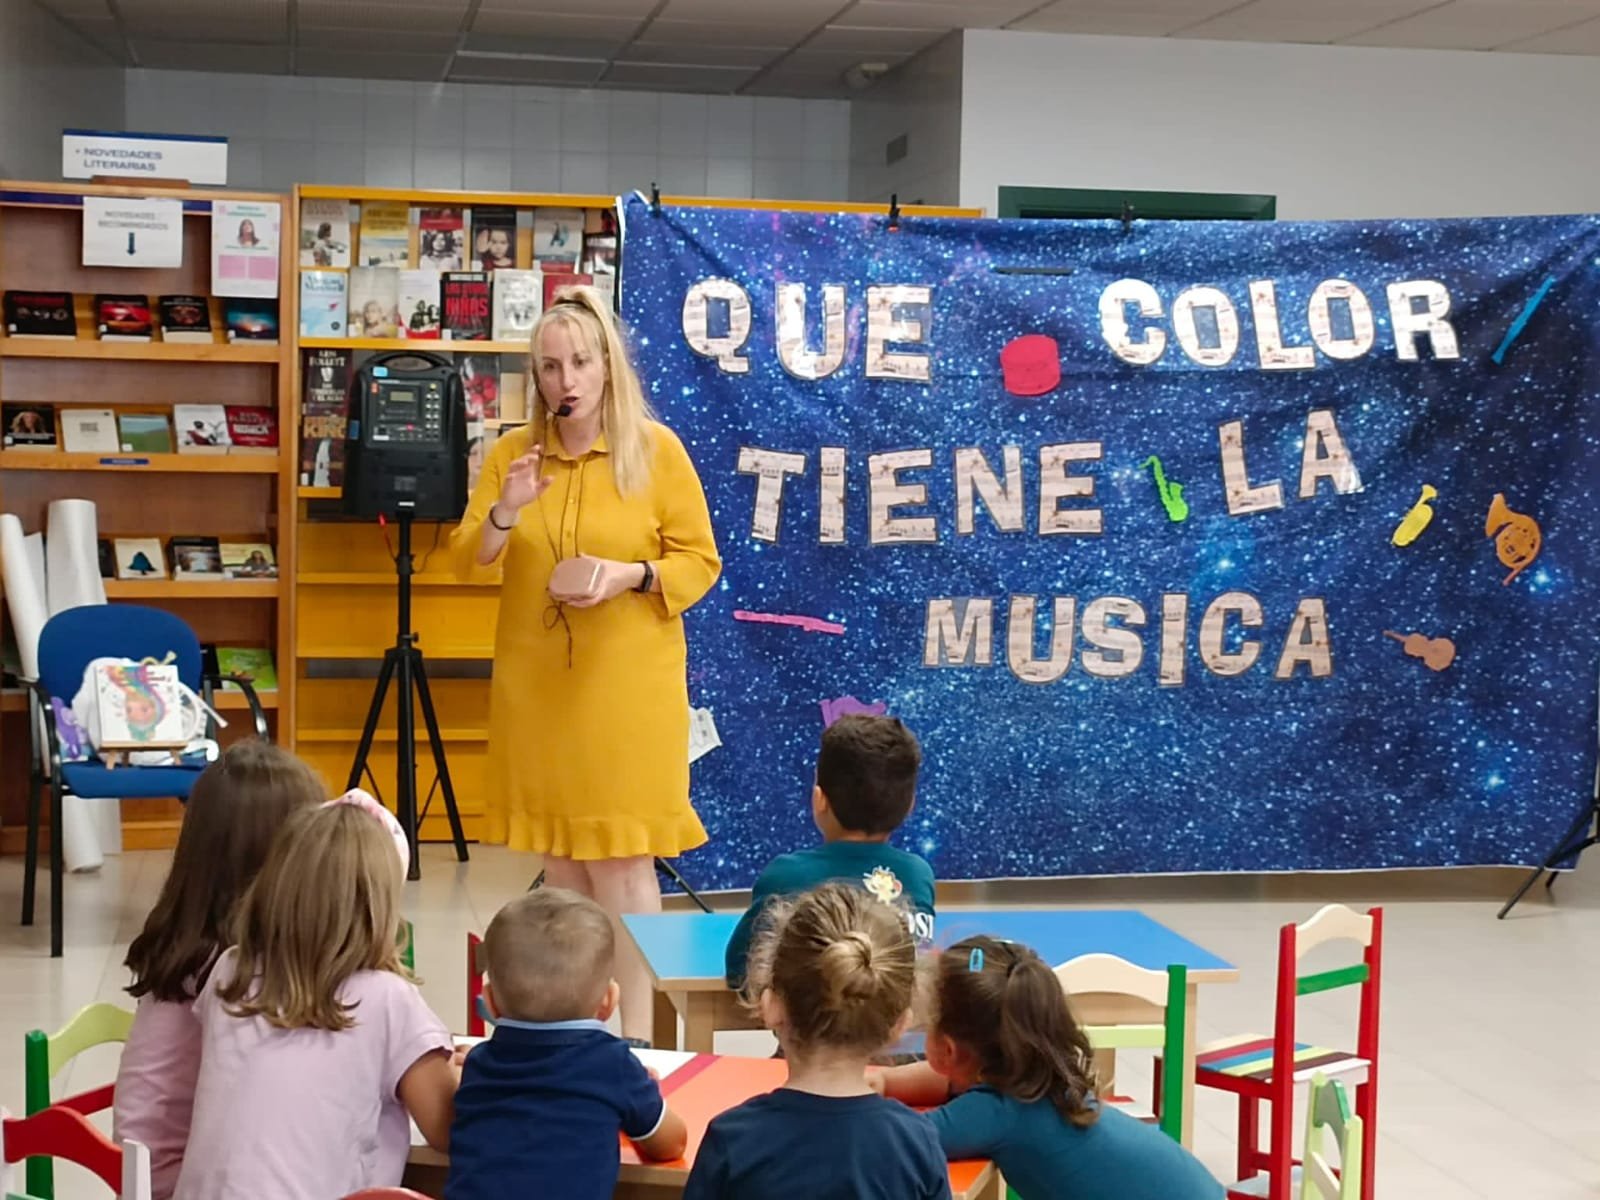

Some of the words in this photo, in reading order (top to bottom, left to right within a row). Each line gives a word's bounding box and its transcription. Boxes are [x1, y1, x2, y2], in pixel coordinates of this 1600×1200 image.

[83, 148, 163, 160] NOVEDADES
[83, 160, 157, 171] LITERARIAS
[682, 277, 933, 383] QUE
[1098, 278, 1460, 370] COLOR
[736, 441, 1104, 545] TIENE
[1218, 408, 1365, 517] LA
[922, 590, 1333, 687] MUSICA
